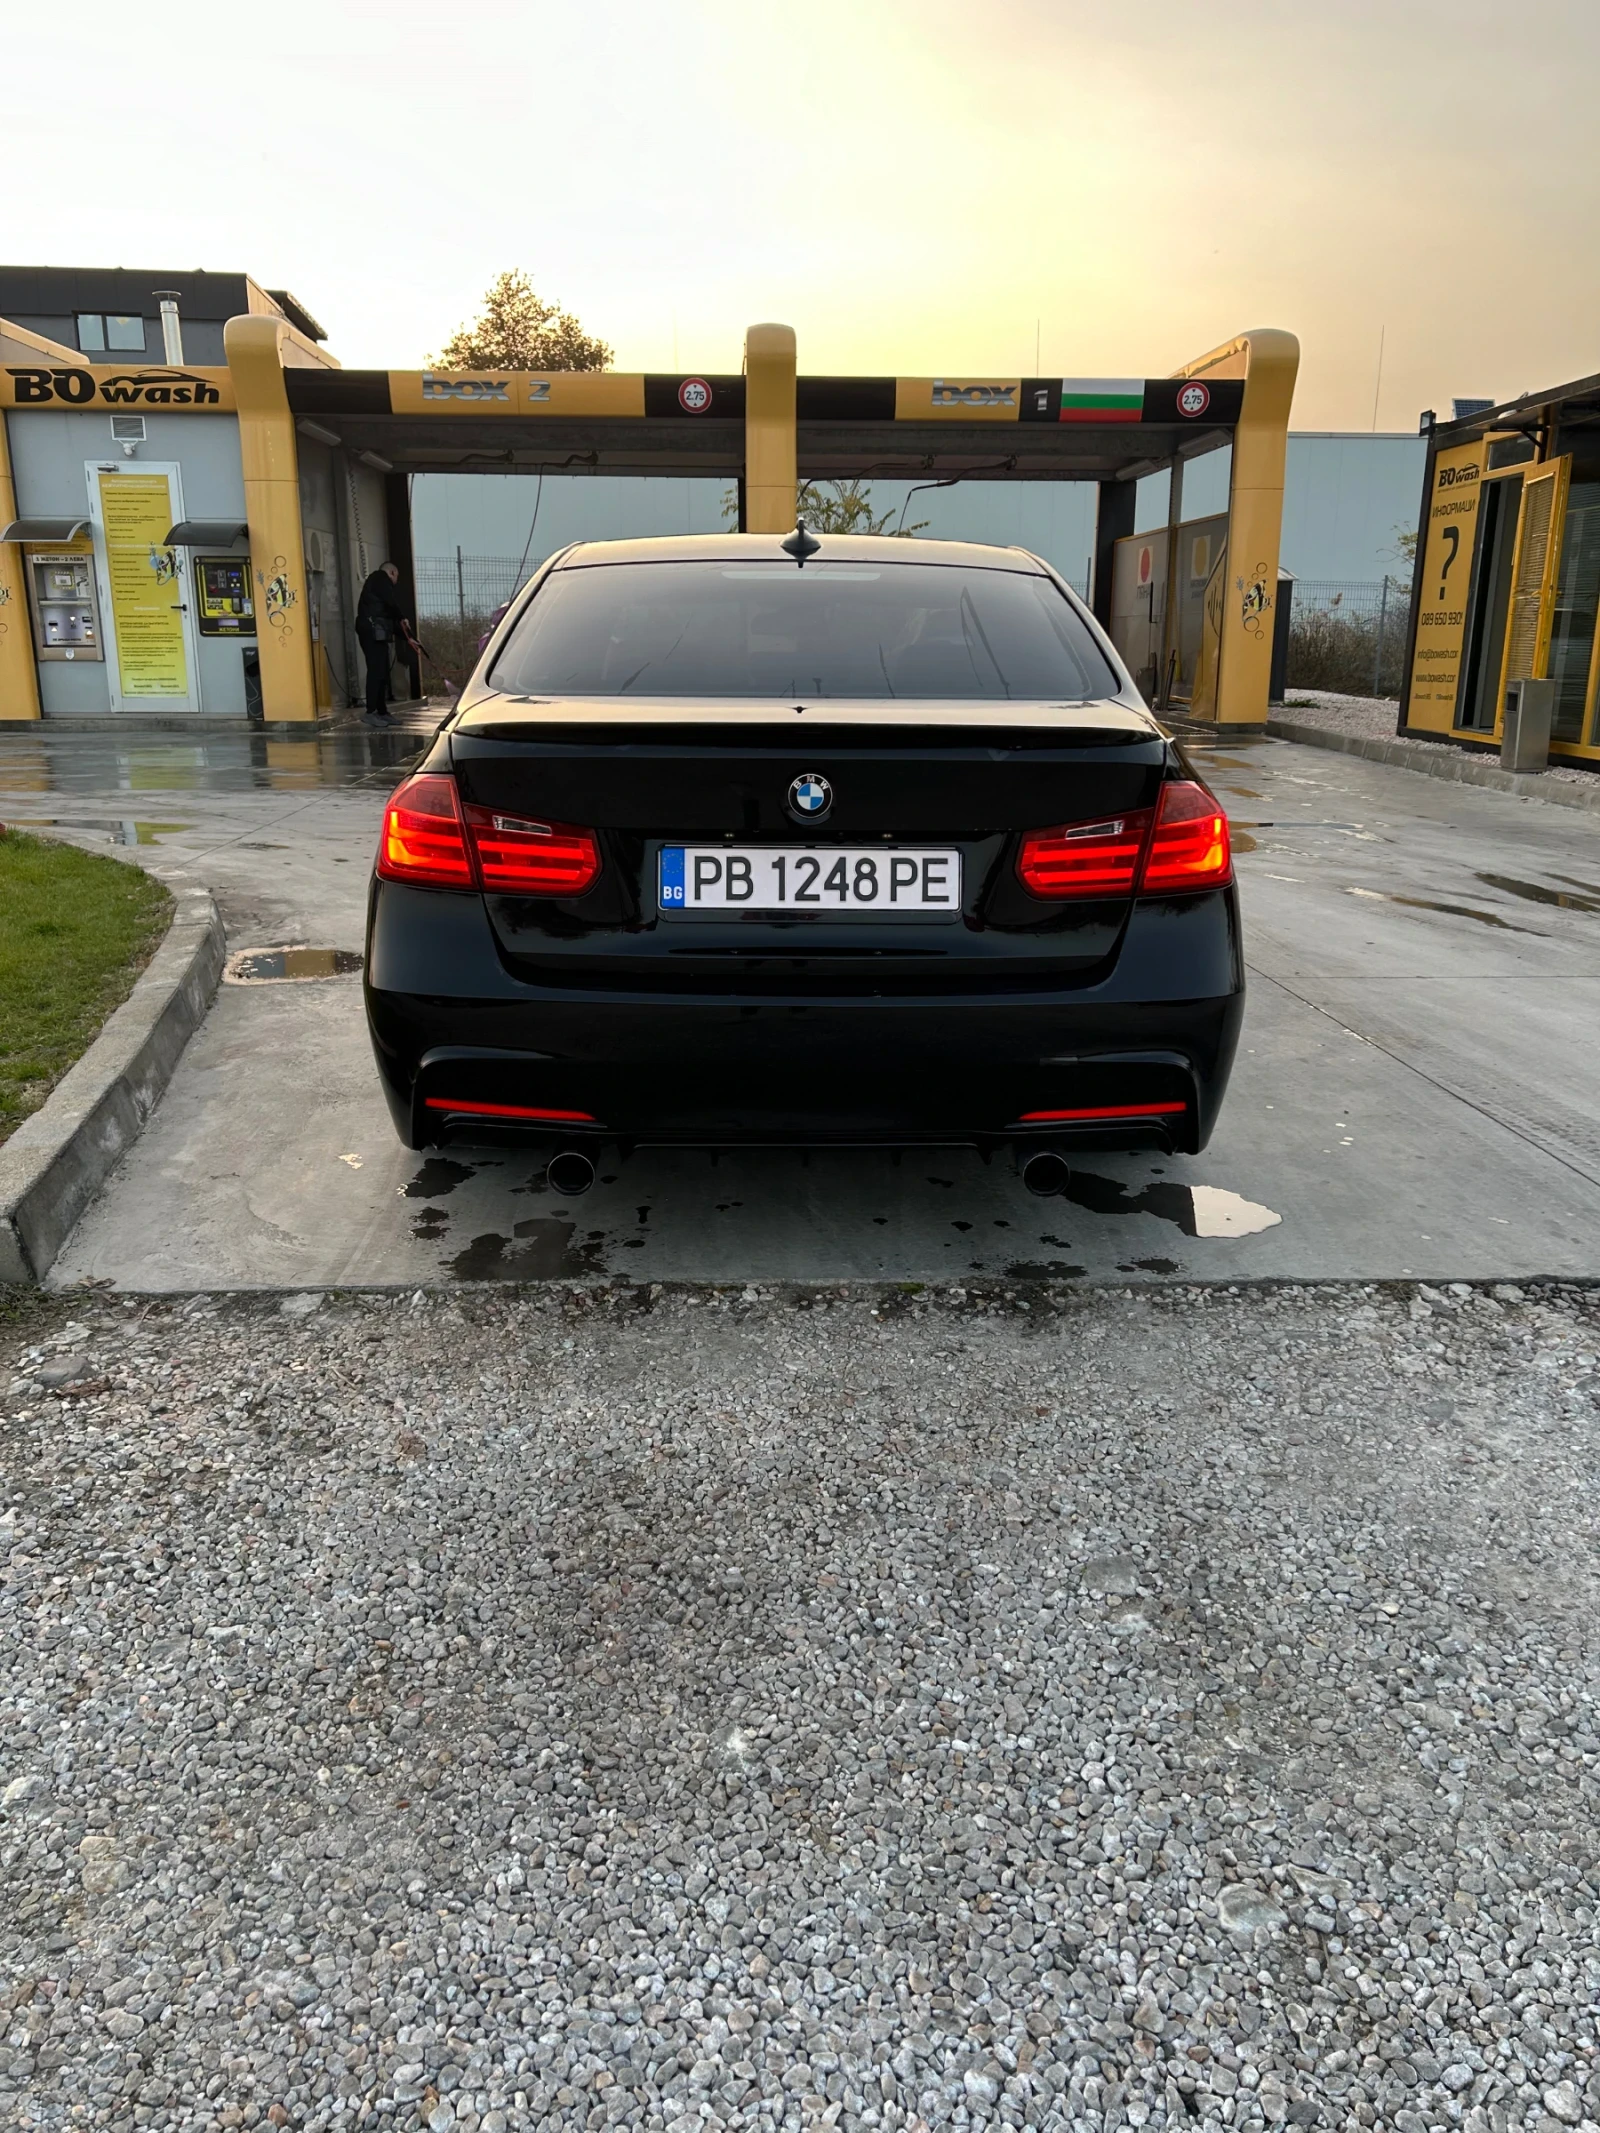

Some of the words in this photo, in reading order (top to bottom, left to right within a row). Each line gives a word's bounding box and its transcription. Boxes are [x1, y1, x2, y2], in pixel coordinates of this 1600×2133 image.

[422, 372, 511, 401] box
[528, 379, 551, 402] 2
[685, 390, 705, 401] 2.75
[931, 380, 1018, 406] box
[1034, 389, 1049, 411] 1
[1183, 394, 1203, 406] 2.75
[1421, 612, 1434, 626] 089
[1434, 611, 1447, 625] 650
[793, 775, 829, 790] BMW
[694, 855, 753, 901] PB
[771, 855, 878, 902] 1248
[890, 857, 950, 903] PE
[663, 886, 683, 900] BG
